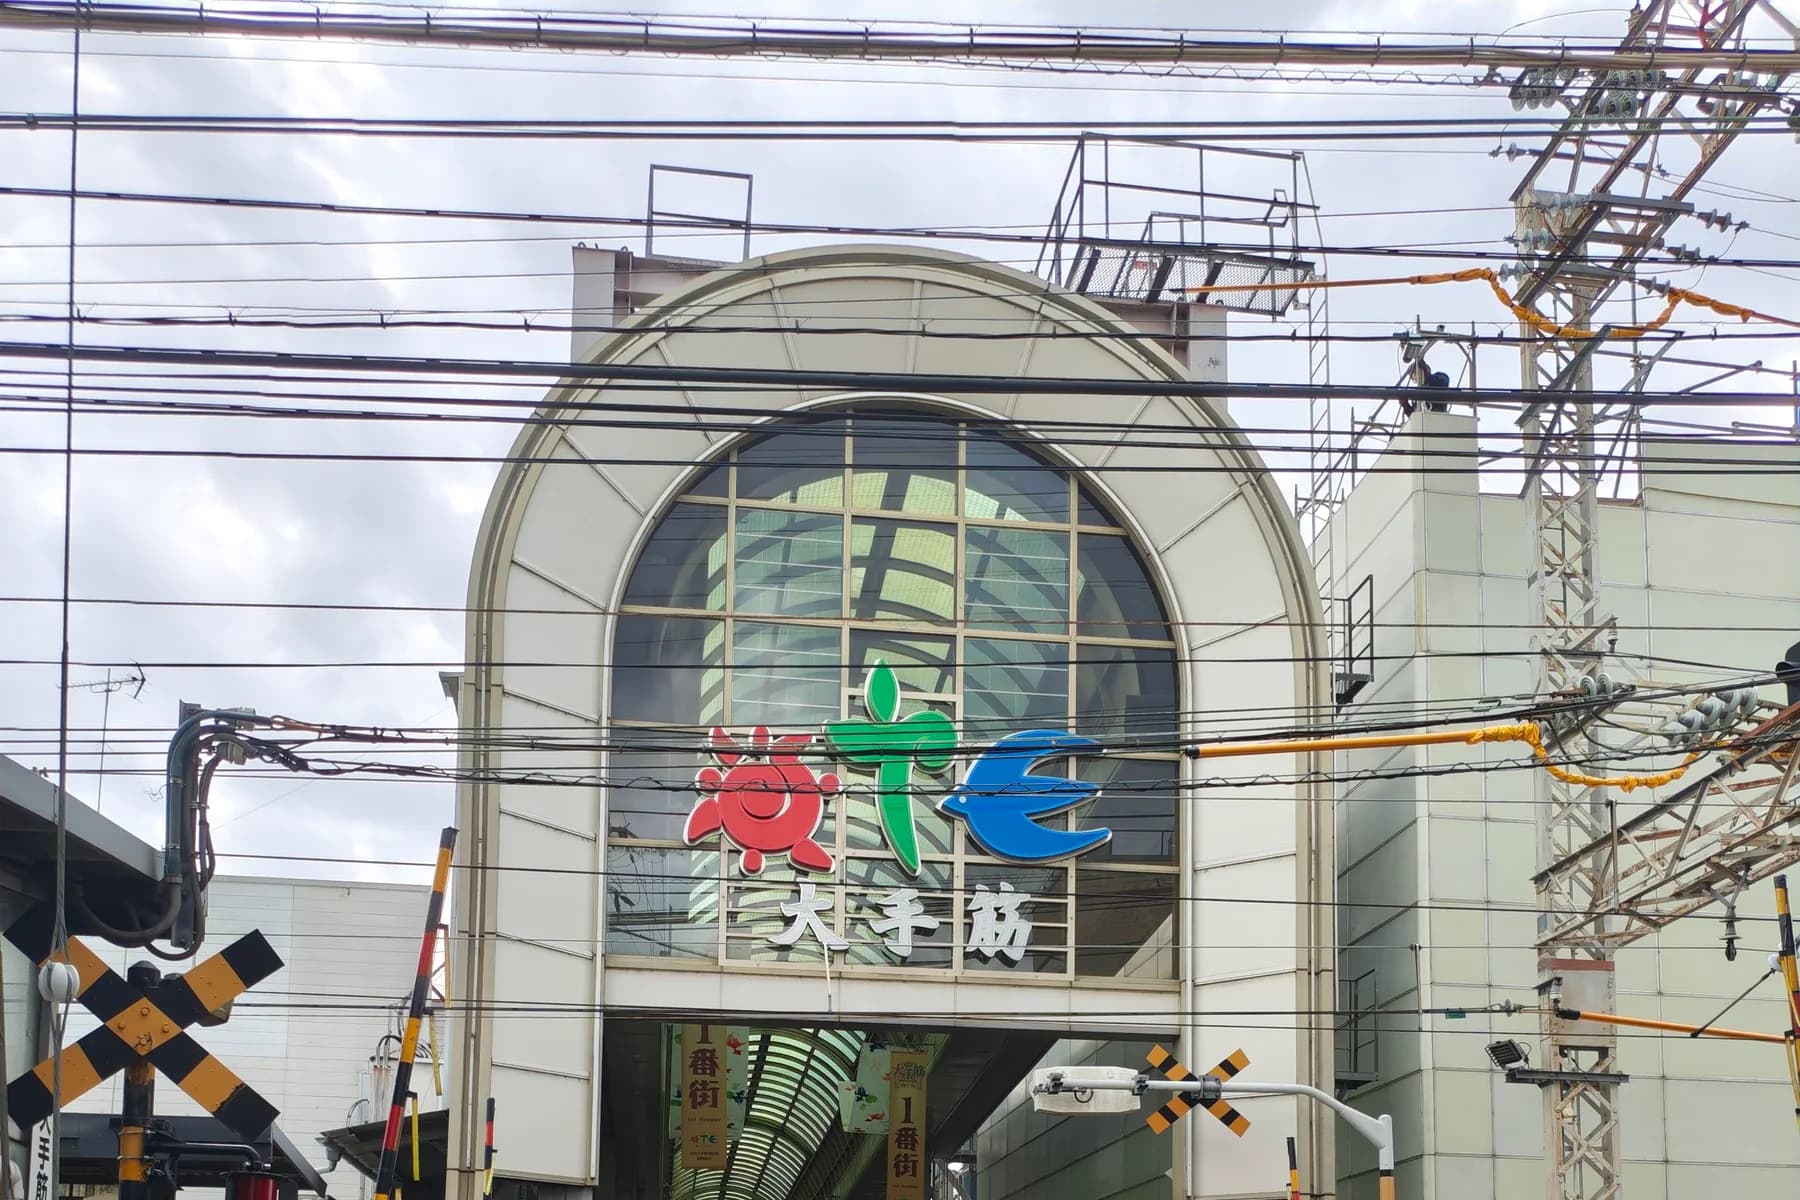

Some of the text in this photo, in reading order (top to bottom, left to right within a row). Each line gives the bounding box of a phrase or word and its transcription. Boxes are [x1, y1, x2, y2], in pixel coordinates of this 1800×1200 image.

[768, 877, 1034, 963] 大手筋
[893, 1096, 919, 1178] 1番街
